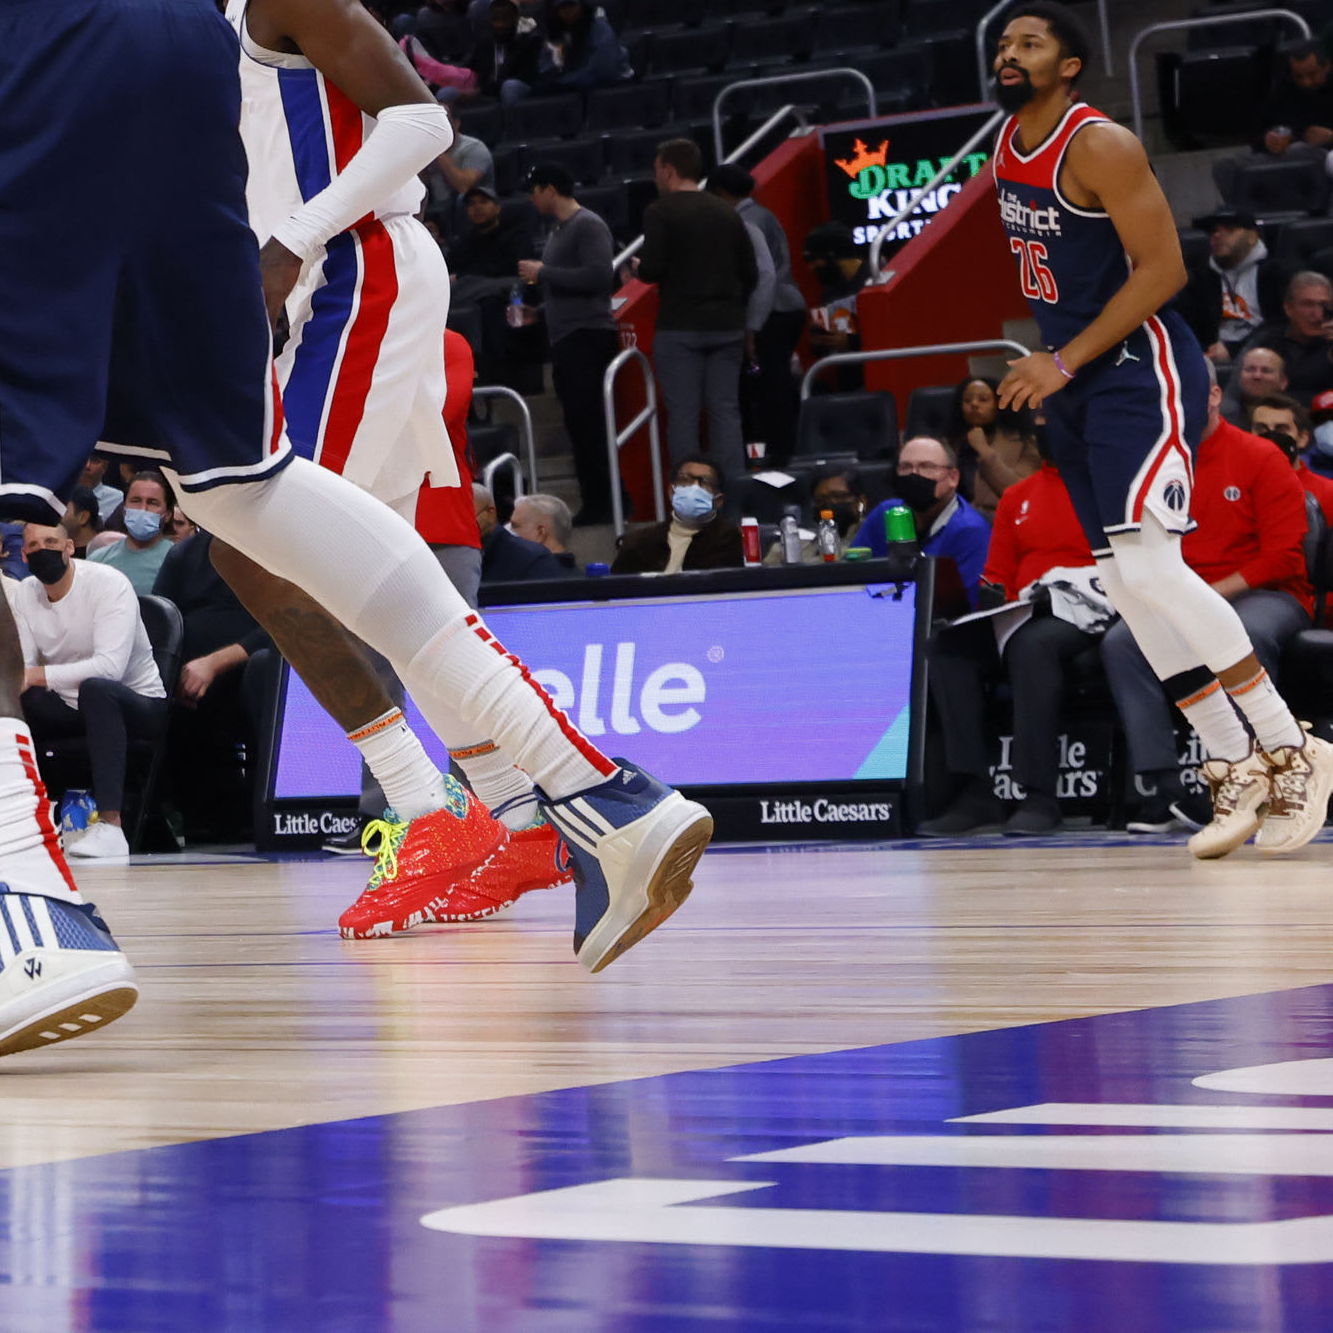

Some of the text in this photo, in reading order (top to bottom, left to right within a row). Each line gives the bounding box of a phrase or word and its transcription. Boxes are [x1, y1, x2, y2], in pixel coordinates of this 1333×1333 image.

[1010, 237, 1058, 304] 26
[760, 799, 890, 823] Little Caesars
[274, 813, 319, 835] Little
